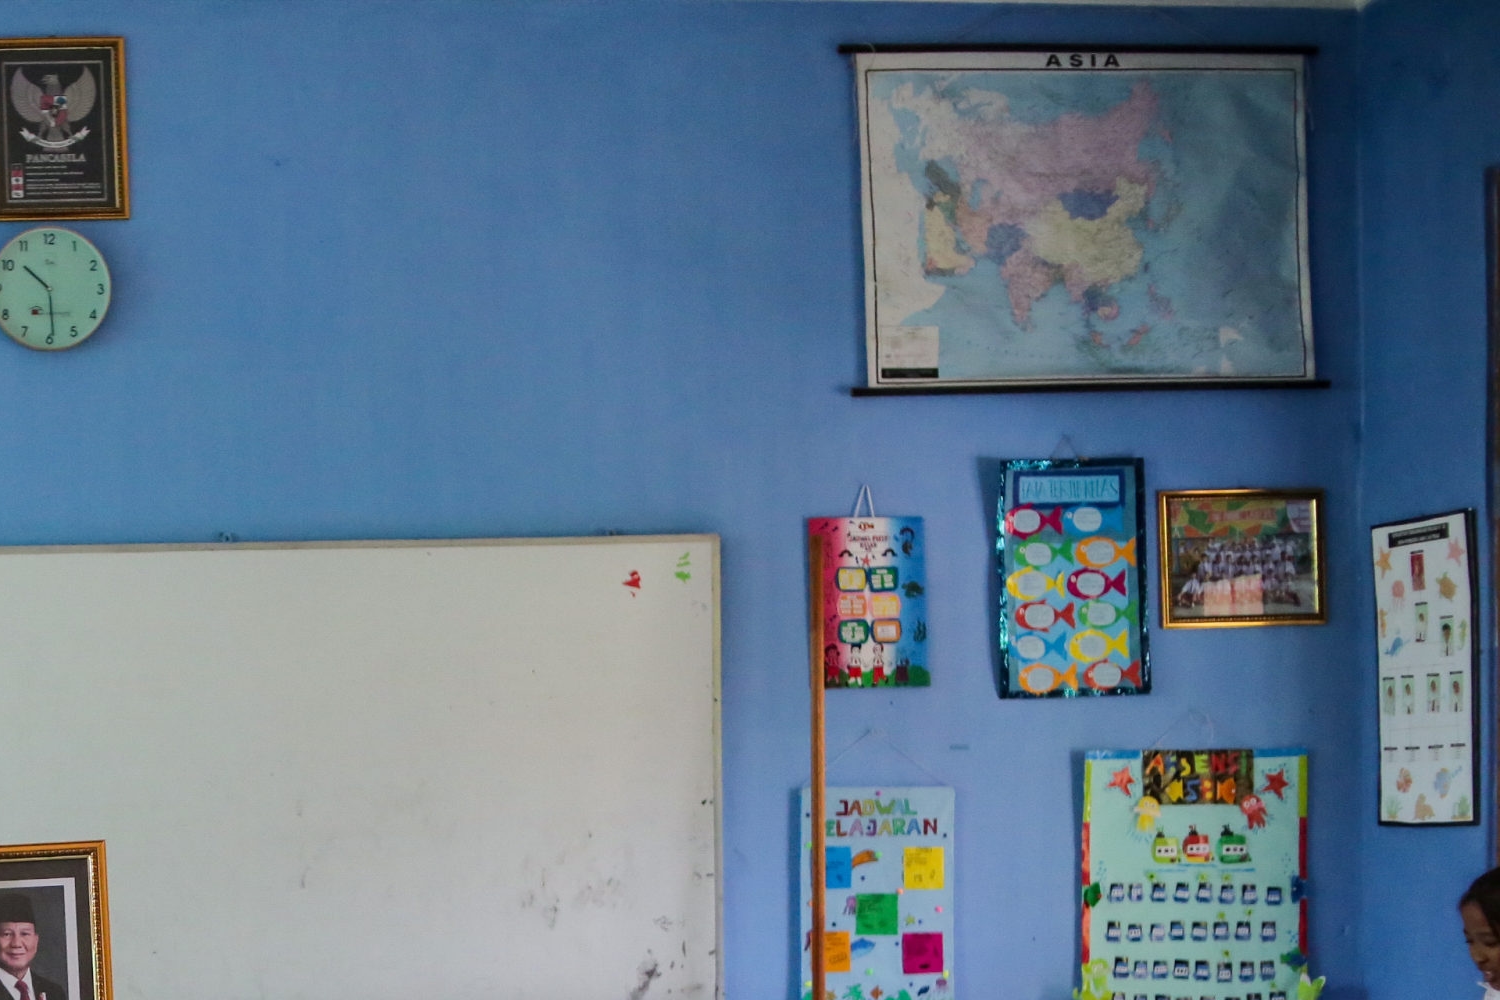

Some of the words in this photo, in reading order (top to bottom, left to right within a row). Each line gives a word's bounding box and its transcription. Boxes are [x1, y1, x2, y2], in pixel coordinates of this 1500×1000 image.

[1045, 54, 1120, 67] ASIA
[25, 153, 87, 164] PANCASILA
[19, 240, 28, 252] 11
[43, 233, 56, 246] 12
[71, 240, 77, 252] 1
[2, 259, 15, 272] 10
[89, 259, 98, 272] 2
[96, 283, 105, 296] 3
[1, 309, 10, 321] 8
[89, 309, 97, 319] 4
[21, 326, 29, 338] 7
[69, 325, 78, 338] 5
[45, 333, 54, 345] 6
[835, 798, 918, 816] JADWAL
[825, 817, 938, 837] ELAJARAN
